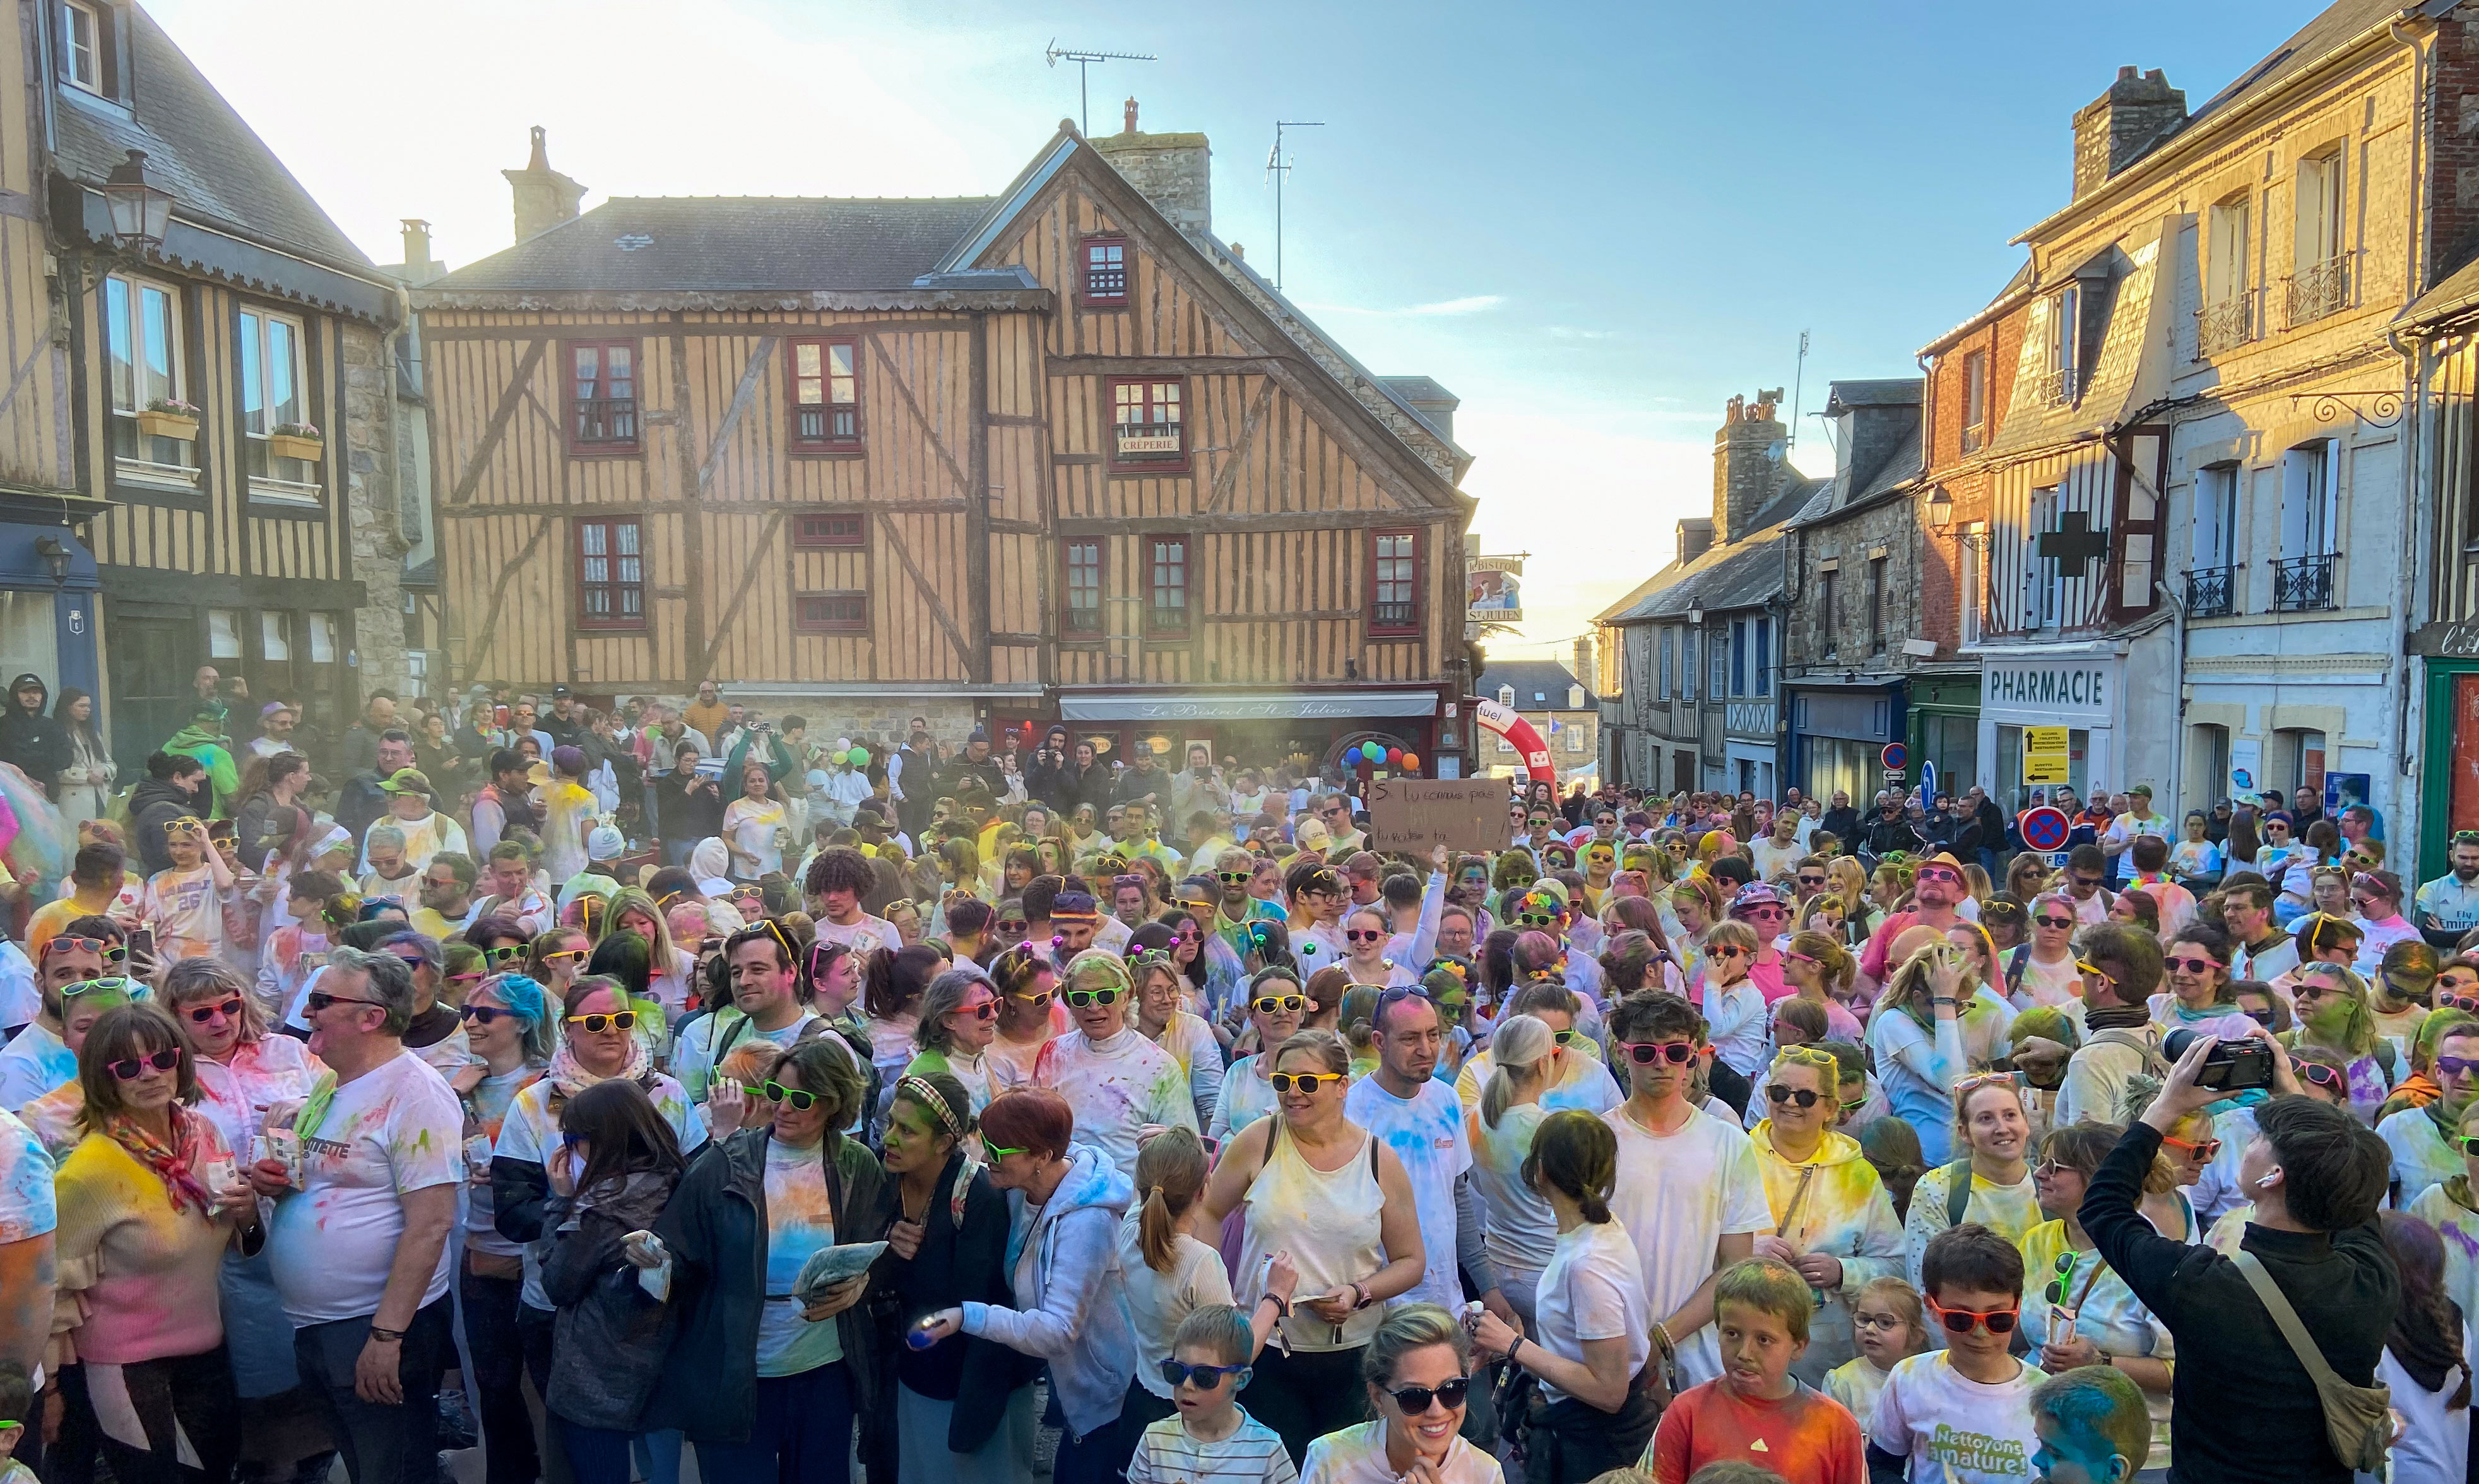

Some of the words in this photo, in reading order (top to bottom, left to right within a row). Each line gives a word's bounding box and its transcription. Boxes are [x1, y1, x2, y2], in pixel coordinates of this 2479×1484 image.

[1123, 439, 1173, 450] CRÊPERIE
[1482, 610, 1520, 620] JULIEN
[1991, 669, 2103, 705] PHARMACIE
[1142, 704, 1169, 717] Le
[1171, 702, 1242, 716] Bistrot
[1285, 701, 1353, 717] Julien
[1479, 705, 1502, 722] tuel
[178, 893, 200, 911] 26
[2456, 910, 2472, 919] Fly
[1936, 1430, 2024, 1456] Nettoyons
